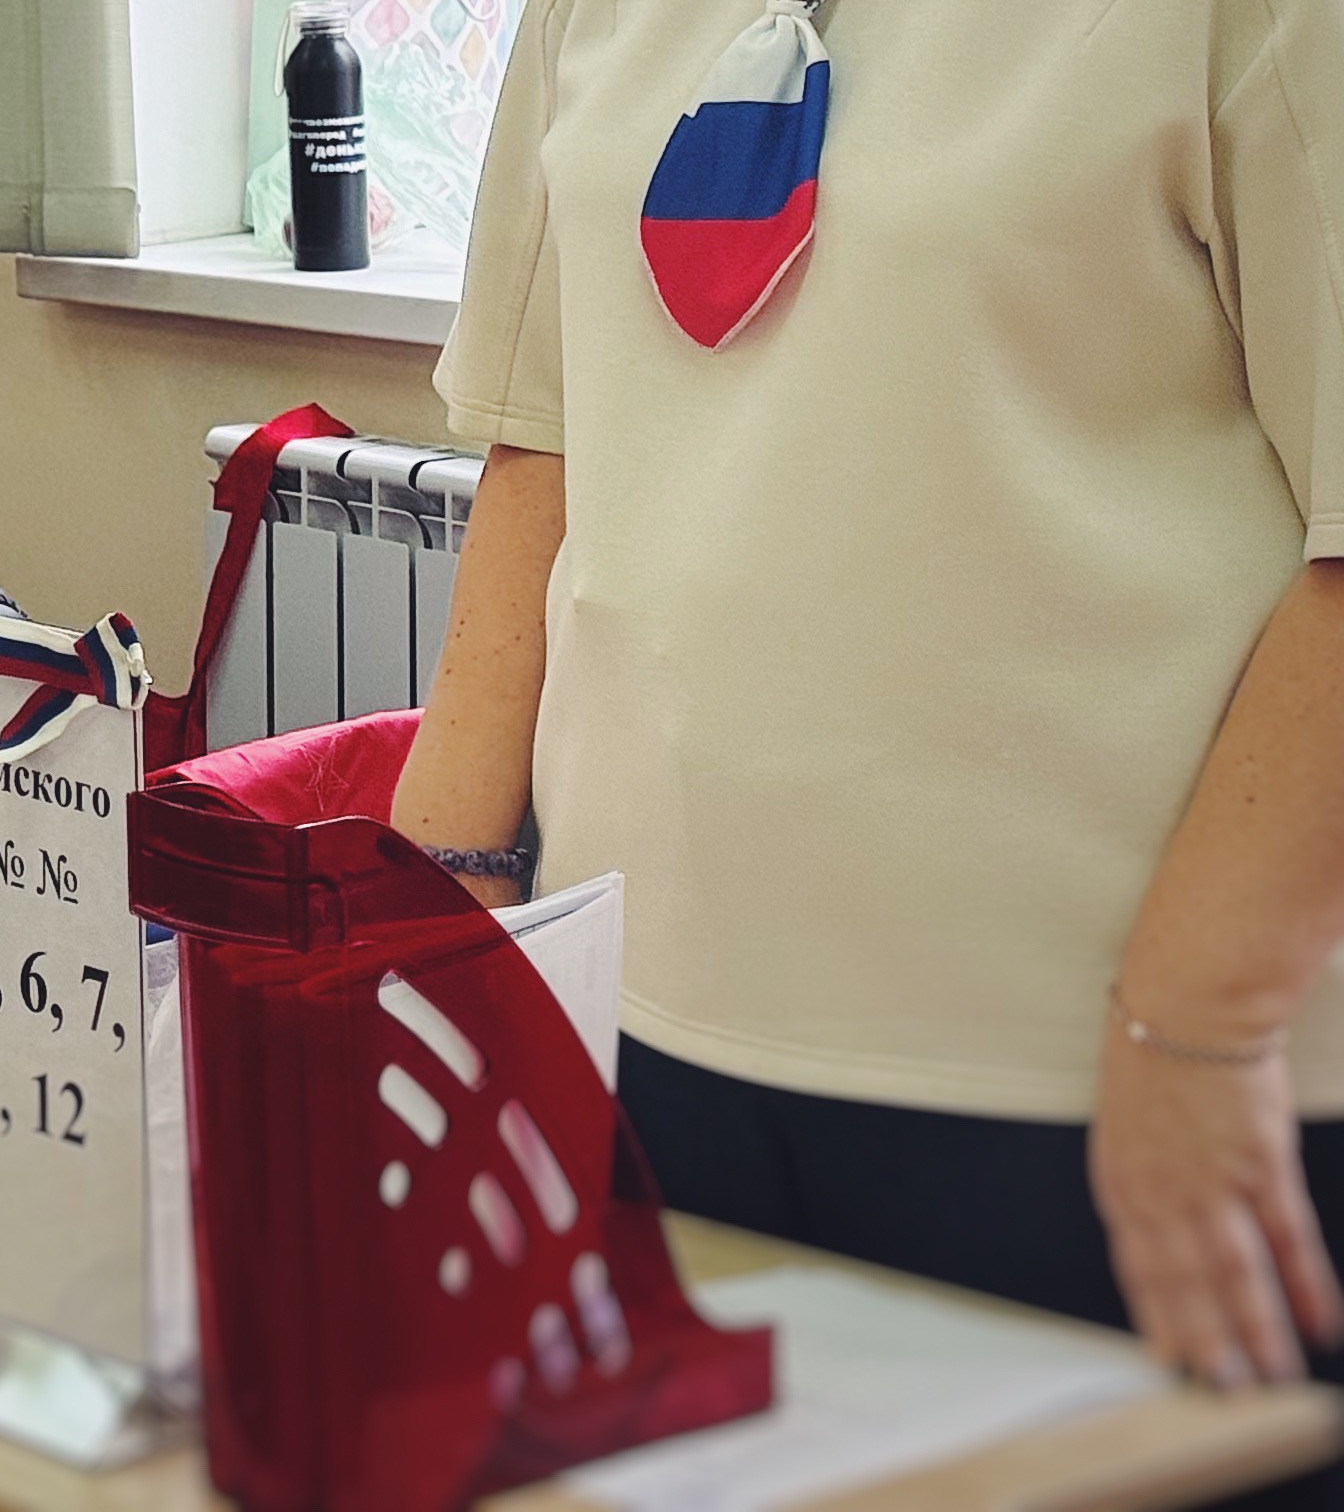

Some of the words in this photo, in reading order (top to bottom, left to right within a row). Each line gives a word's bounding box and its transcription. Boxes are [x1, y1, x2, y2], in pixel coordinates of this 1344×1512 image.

[36, 849, 79, 905] №
[20, 951, 64, 1032] 6,
[80, 965, 127, 1053] 7,
[31, 1074, 87, 1148] 12
